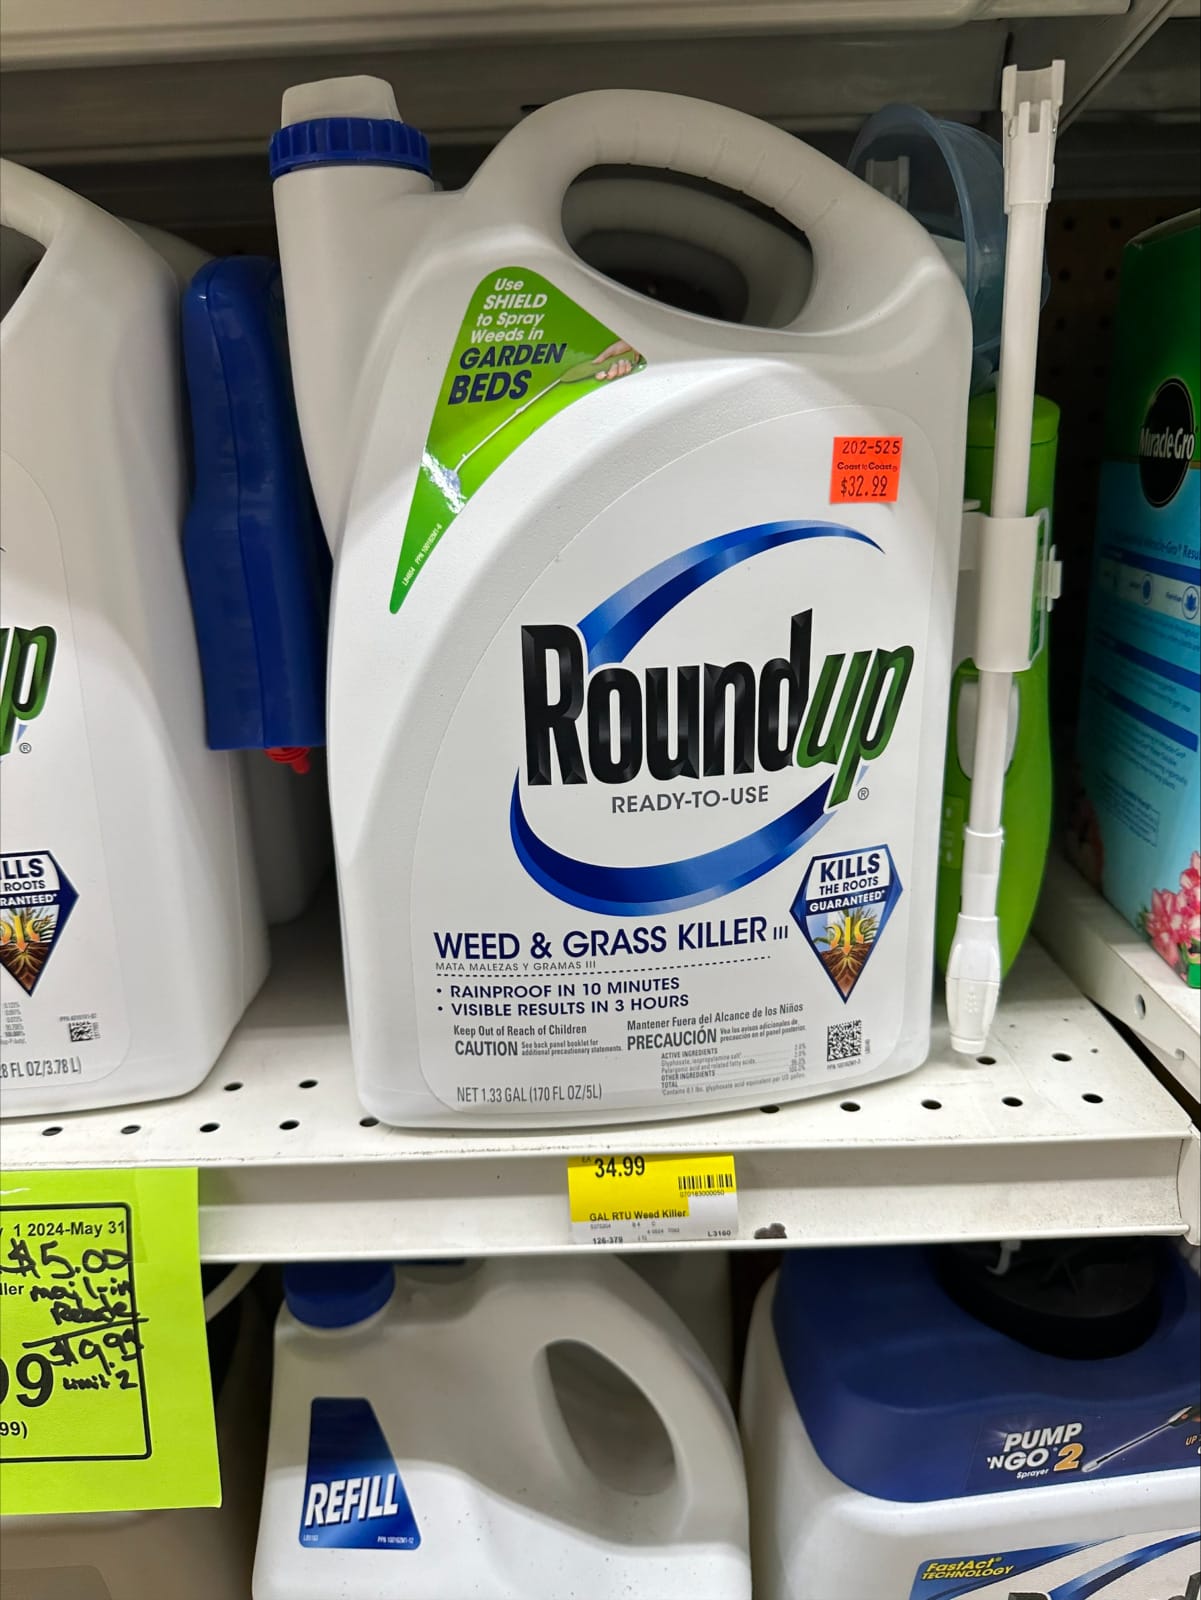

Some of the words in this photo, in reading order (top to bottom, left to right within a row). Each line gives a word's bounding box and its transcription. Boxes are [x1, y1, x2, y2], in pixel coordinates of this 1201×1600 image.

[494, 278, 524, 291] Use
[483, 294, 548, 310] SHIELD
[476, 313, 493, 327] to
[496, 312, 545, 328] Spray
[471, 328, 524, 344] Weeds
[528, 326, 544, 340] in
[459, 343, 567, 370] GARDEN
[448, 369, 532, 405] BEDS
[842, 440, 900, 455] 202-525
[837, 462, 861, 470] Coast
[868, 461, 892, 470] Coast
[840, 475, 888, 497] $32.99
[520, 607, 915, 809] Roundup
[610, 784, 770, 814] READY-TO-USE
[0, 858, 45, 880] LLS
[820, 853, 881, 883] KILLS
[4, 880, 46, 892] ROOTS
[819, 883, 840, 896] THE
[842, 876, 879, 892] ROOTS
[433, 931, 520, 960] WEED
[529, 931, 553, 960] &
[563, 924, 668, 958] GRASS
[677, 916, 767, 951] KILLER
[773, 925, 789, 941] III
[435, 962, 466, 971] MATA
[469, 962, 519, 971] MALEZAS
[522, 962, 529, 971] Y
[533, 961, 582, 971] GRAMAS
[585, 960, 596, 969] III
[450, 984, 552, 998] RAINPROOF
[558, 983, 575, 997] IN
[582, 983, 602, 996] 10
[607, 976, 681, 995] MINUTES
[451, 1003, 512, 1017] VISIBLE
[518, 1001, 586, 1016] RESULTS
[591, 1000, 609, 1013] IN
[615, 999, 625, 1012] 3
[631, 994, 690, 1011] HOURS
[627, 1018, 670, 1031] Mantener
[672, 1015, 697, 1027] Fuera
[699, 1014, 712, 1025] del
[714, 1011, 750, 1023] Alcance
[752, 1008, 763, 1018] de
[765, 1006, 777, 1017] los
[779, 1003, 804, 1015] Niños
[453, 1025, 476, 1039] Keep
[478, 1025, 494, 1036] Out
[496, 1025, 505, 1036] of
[507, 1025, 535, 1036] Reach
[537, 1025, 547, 1036] of
[549, 1024, 587, 1036] Children
[627, 1025, 717, 1051] PRECAUCIÓN
[455, 1040, 518, 1056] CAUTION
[521, 1041, 533, 1049] See
[533, 1040, 548, 1048] back
[549, 1040, 566, 1049] panel
[567, 1039, 589, 1047] booklet
[661, 1052, 681, 1060] ACTIVE
[682, 1048, 718, 1058] INGREDIENTS
[10, 1062, 25, 1078] FL
[26, 1058, 69, 1077] OZ/3.78
[70, 1056, 82, 1075] L)
[661, 1073, 679, 1082] OTHER
[680, 1070, 716, 1080] INGREDIENTS
[457, 1086, 478, 1102] NET
[481, 1086, 502, 1103] 1.33
[504, 1086, 527, 1102] GAL
[529, 1085, 550, 1103] (170
[552, 1085, 565, 1100] FL
[567, 1083, 602, 1101] OZ/5L)
[661, 1081, 678, 1089] TOTAL
[594, 1155, 646, 1178] 34.99
[589, 1212, 609, 1222] GAL
[612, 1210, 632, 1220] RTU
[634, 1210, 660, 1220] Weed
[662, 1208, 686, 1218] Killer
[13, 1223, 21, 1237] 1
[27, 1221, 103, 1238] 2024-May
[108, 1220, 125, 1235] 31
[115, 1369, 138, 1390] 2
[1003, 1422, 1083, 1453] PUMP
[1053, 1442, 1084, 1472] 2
[1016, 1468, 1050, 1479] Sprayer
[304, 1473, 400, 1528] REFILL
[921, 1565, 1015, 1580] TECHNOLOGY
[926, 1557, 995, 1572] FastAct
